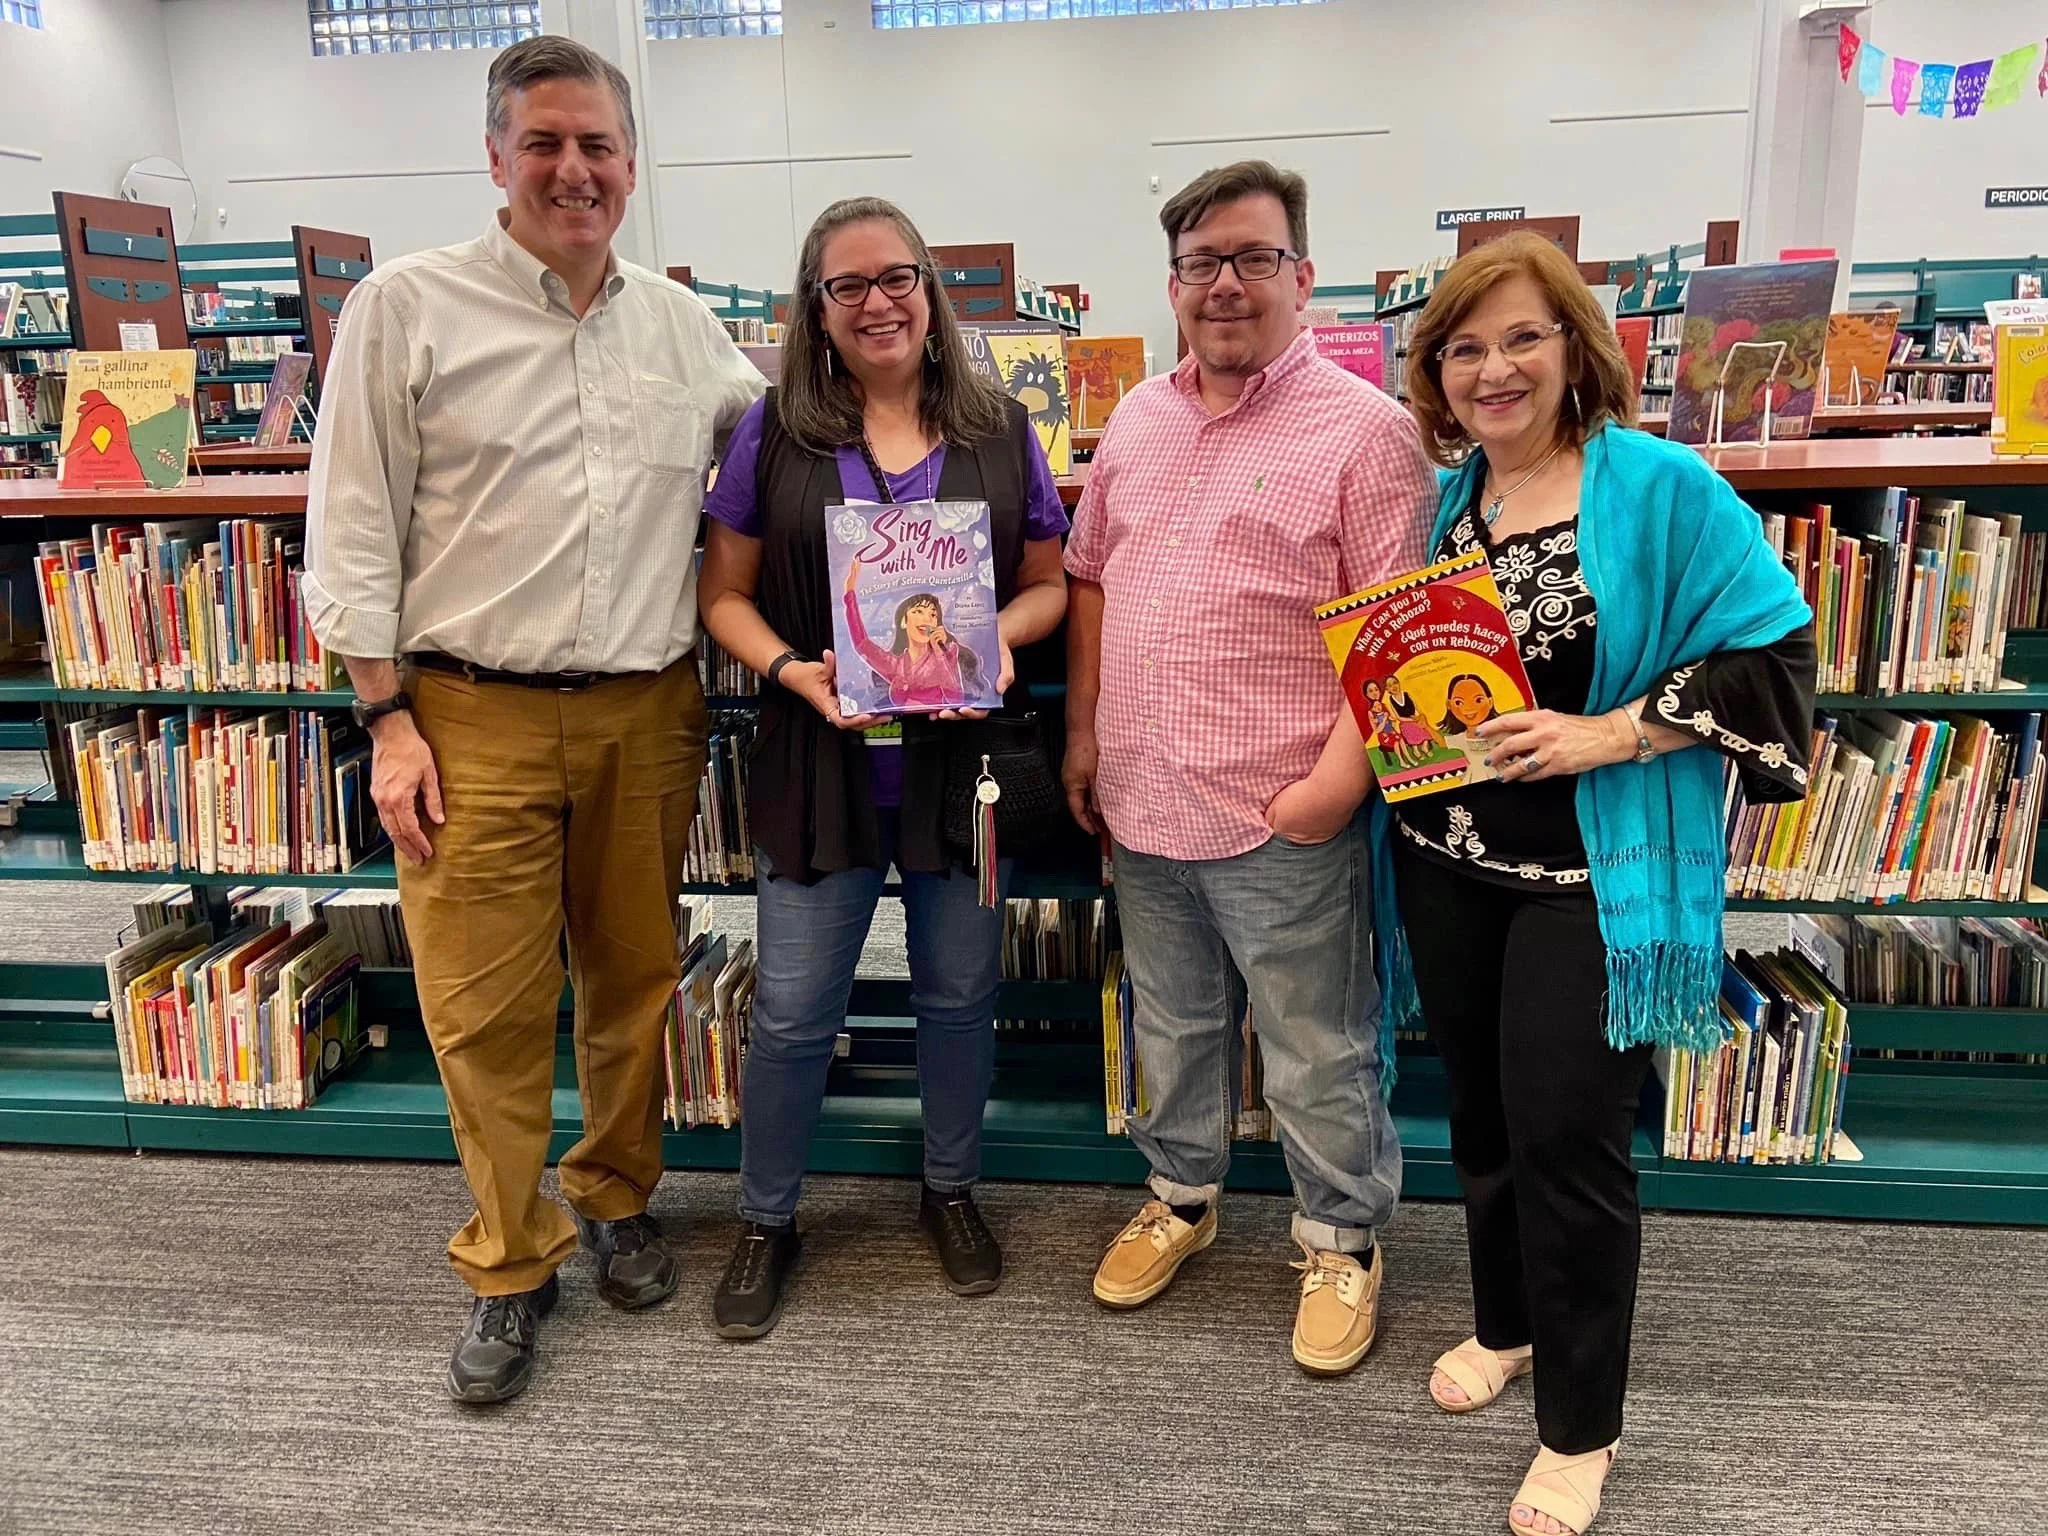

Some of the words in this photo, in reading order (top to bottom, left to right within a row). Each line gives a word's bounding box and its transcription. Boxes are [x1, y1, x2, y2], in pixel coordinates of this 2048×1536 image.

[1440, 211, 1482, 225] LARGE
[1486, 209, 1523, 221] PRINT
[125, 238, 133, 252] 7
[339, 262, 346, 274] 8
[953, 271, 966, 281] 14
[1315, 330, 1379, 344] ONTERIZOS
[103, 359, 148, 376] gallina
[97, 377, 172, 390] hambrienta
[855, 508, 932, 564] Sing
[881, 547, 916, 575] with
[925, 535, 968, 571] Me
[901, 576, 926, 586] Selena
[928, 572, 974, 587] Quintanilla
[1354, 626, 1375, 652] What
[1389, 597, 1410, 614] You
[1411, 589, 1428, 602] Do
[1367, 636, 1386, 658] with
[1383, 629, 1393, 638] a
[1388, 598, 1432, 631] Rebozo?
[1400, 624, 1427, 644] ¿Qué
